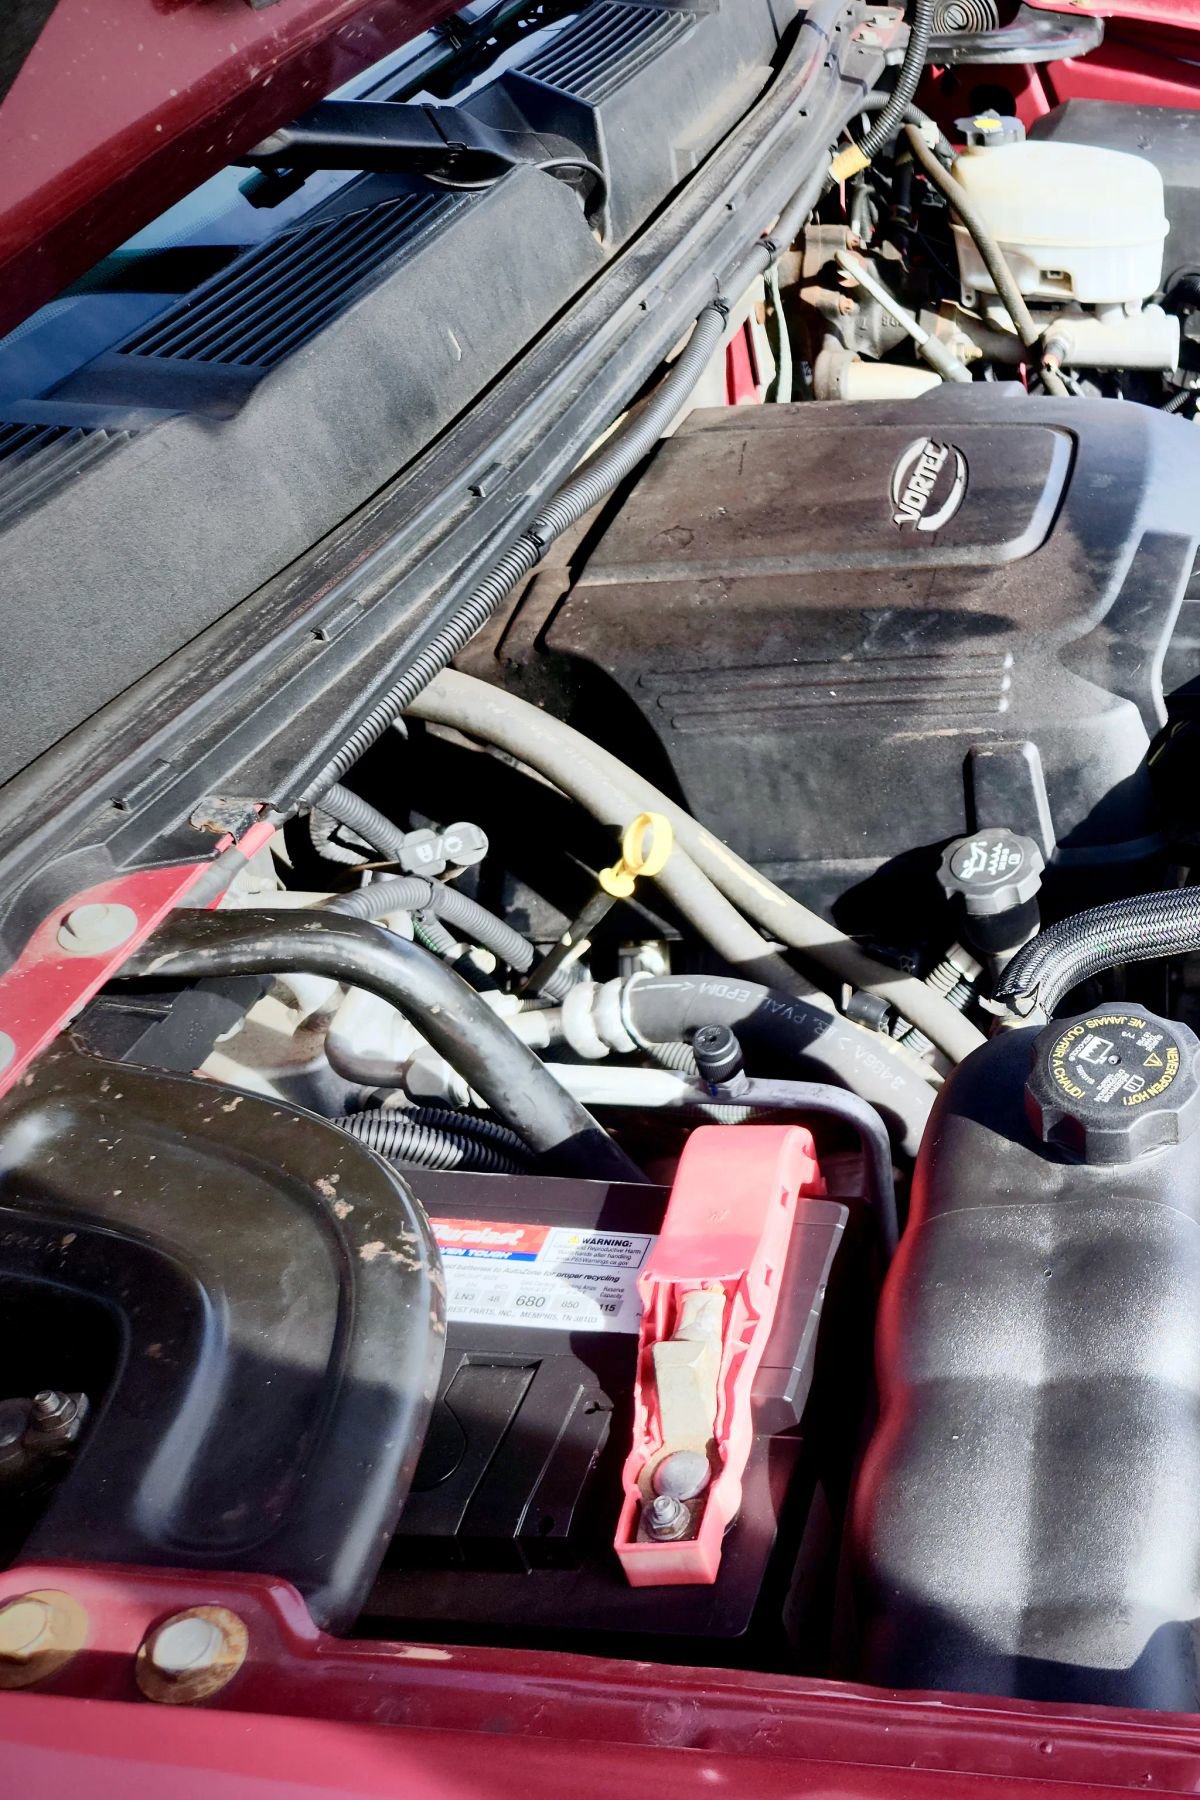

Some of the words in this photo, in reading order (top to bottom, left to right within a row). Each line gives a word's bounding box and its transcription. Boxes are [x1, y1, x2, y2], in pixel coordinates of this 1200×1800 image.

[893, 440, 949, 526] VORTEC
[700, 983, 752, 1003] EPDM
[1086, 1015, 1128, 1029] JAMAIS
[1128, 1017, 1146, 1029] NE
[1053, 1026, 1084, 1058] OUVRIR
[1166, 1047, 1179, 1077] NEVER
[1053, 1068, 1086, 1099] CHAUD!
[1151, 1076, 1173, 1097] OPEN
[1123, 1092, 1150, 1106] HOT!
[582, 1237, 633, 1248] WARNING:
[440, 1247, 467, 1257] VEN
[469, 1248, 513, 1260] TOUGH
[556, 1272, 584, 1281] proper
[583, 1274, 621, 1284] recycling
[600, 1291, 624, 1300] Capacity
[515, 1295, 546, 1308] 680
[600, 1304, 616, 1312] 115
